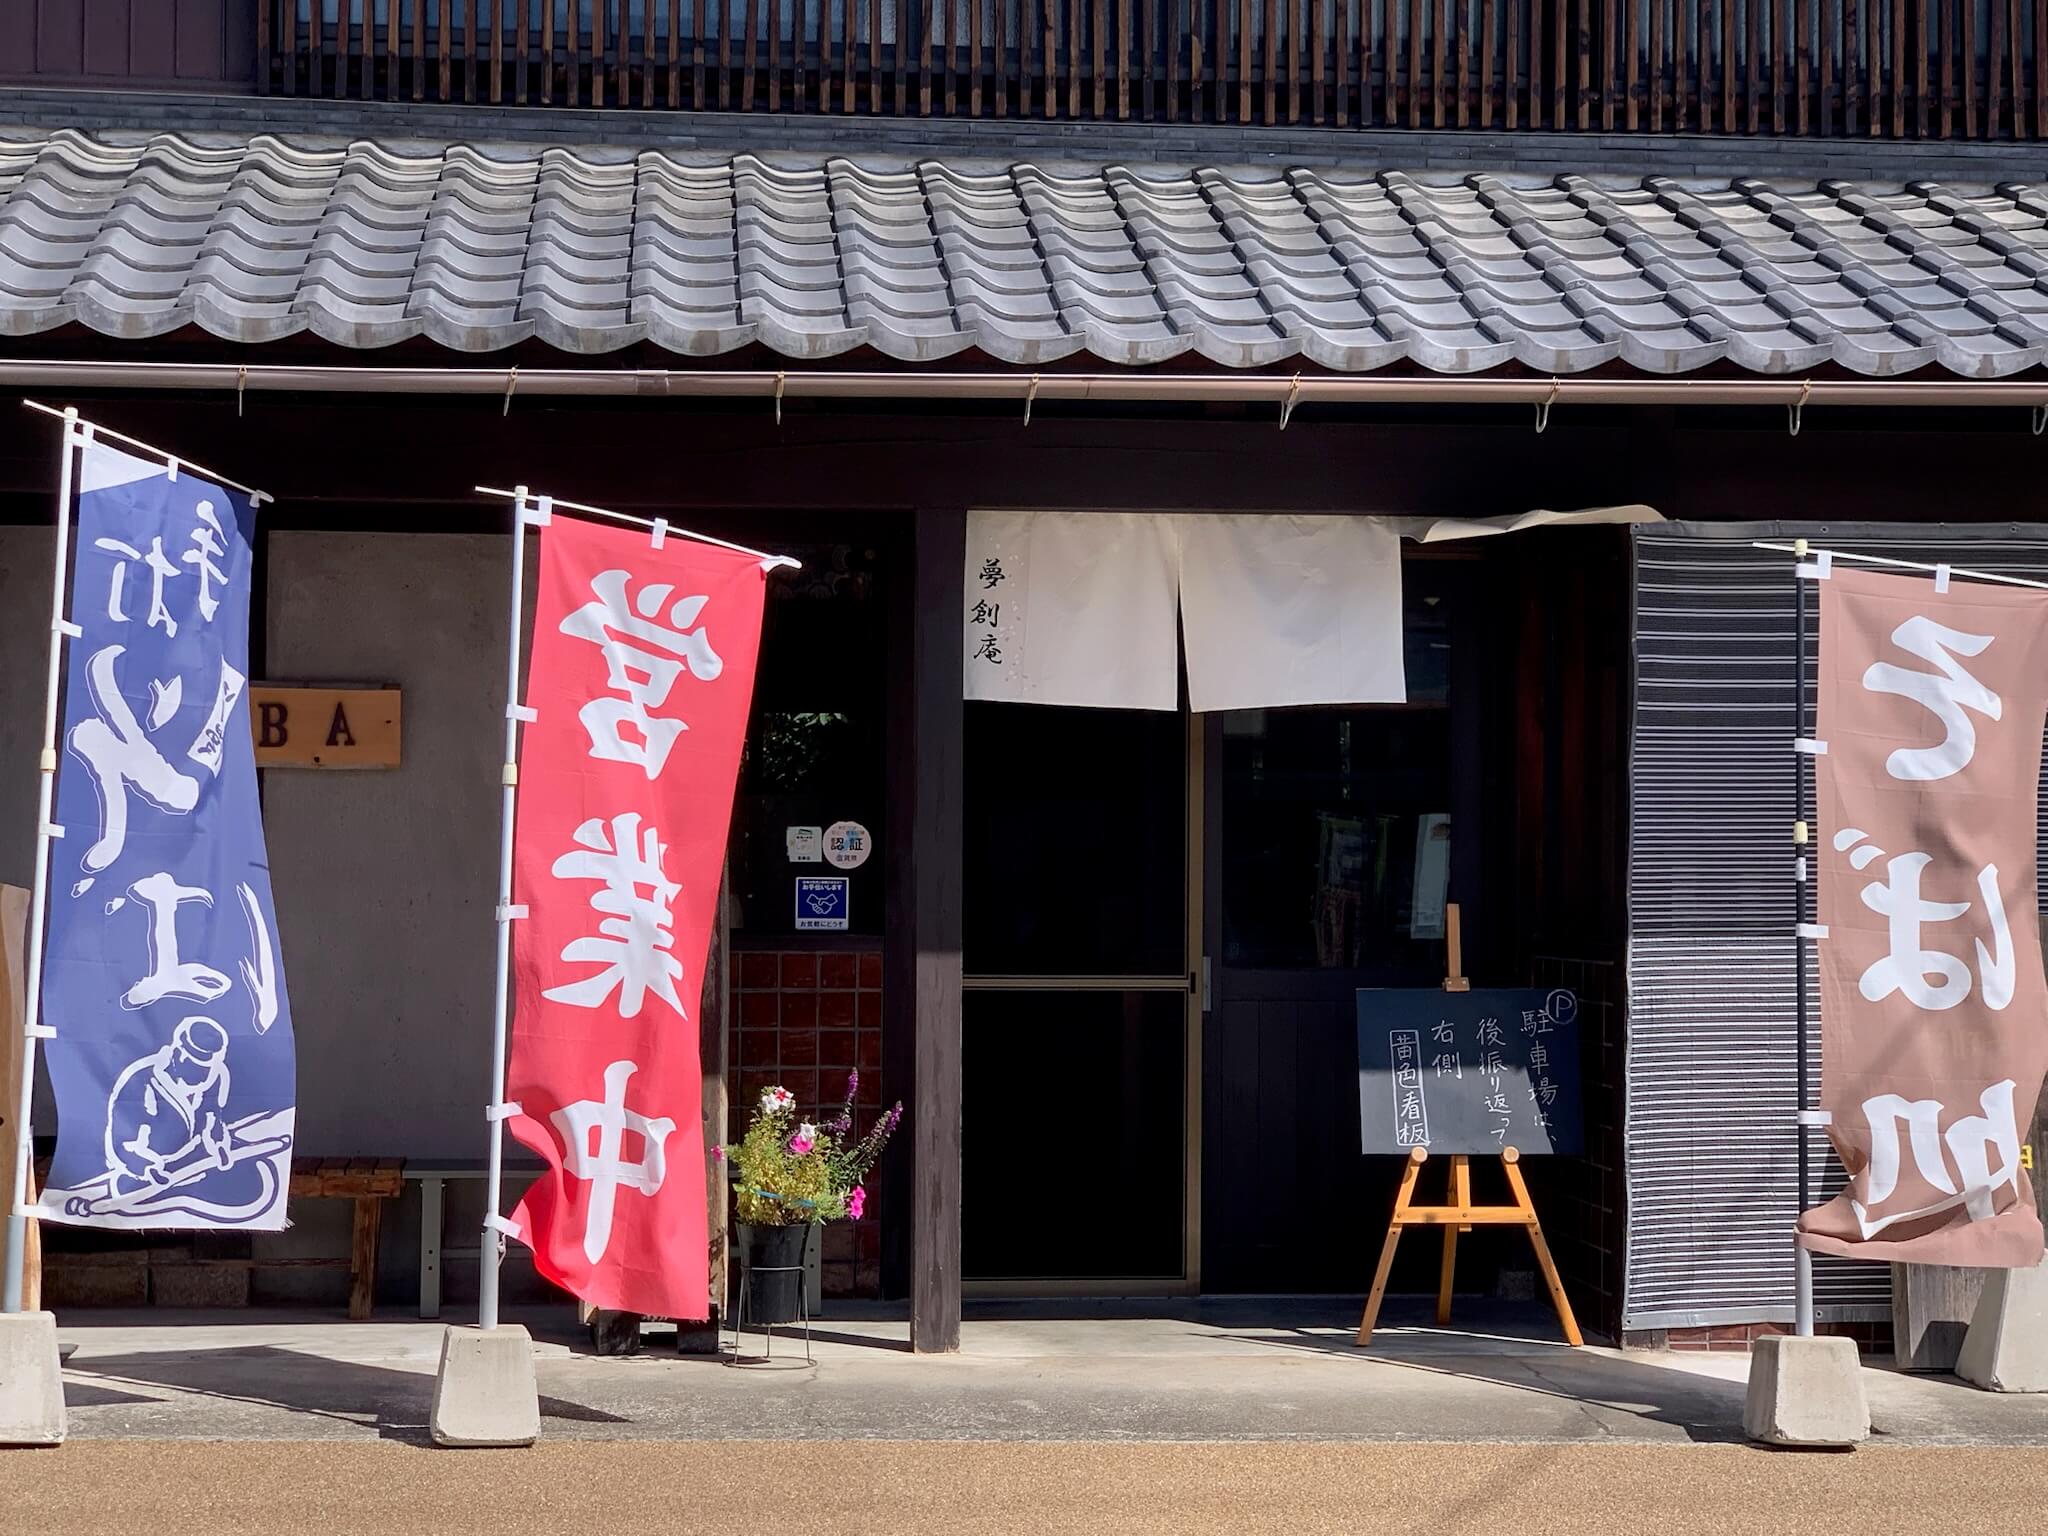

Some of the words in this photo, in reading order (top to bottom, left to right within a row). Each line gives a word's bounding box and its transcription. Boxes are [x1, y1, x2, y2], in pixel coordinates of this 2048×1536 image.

[969, 557, 1006, 665] 夢創庵
[830, 836, 864, 851] 認証
[799, 920, 844, 928] お気軽にどうぞ
[1391, 1033, 1431, 1146] 黄色看板
[1430, 1019, 1463, 1080] 右側
[1475, 1017, 1513, 1145] 後振り返って
